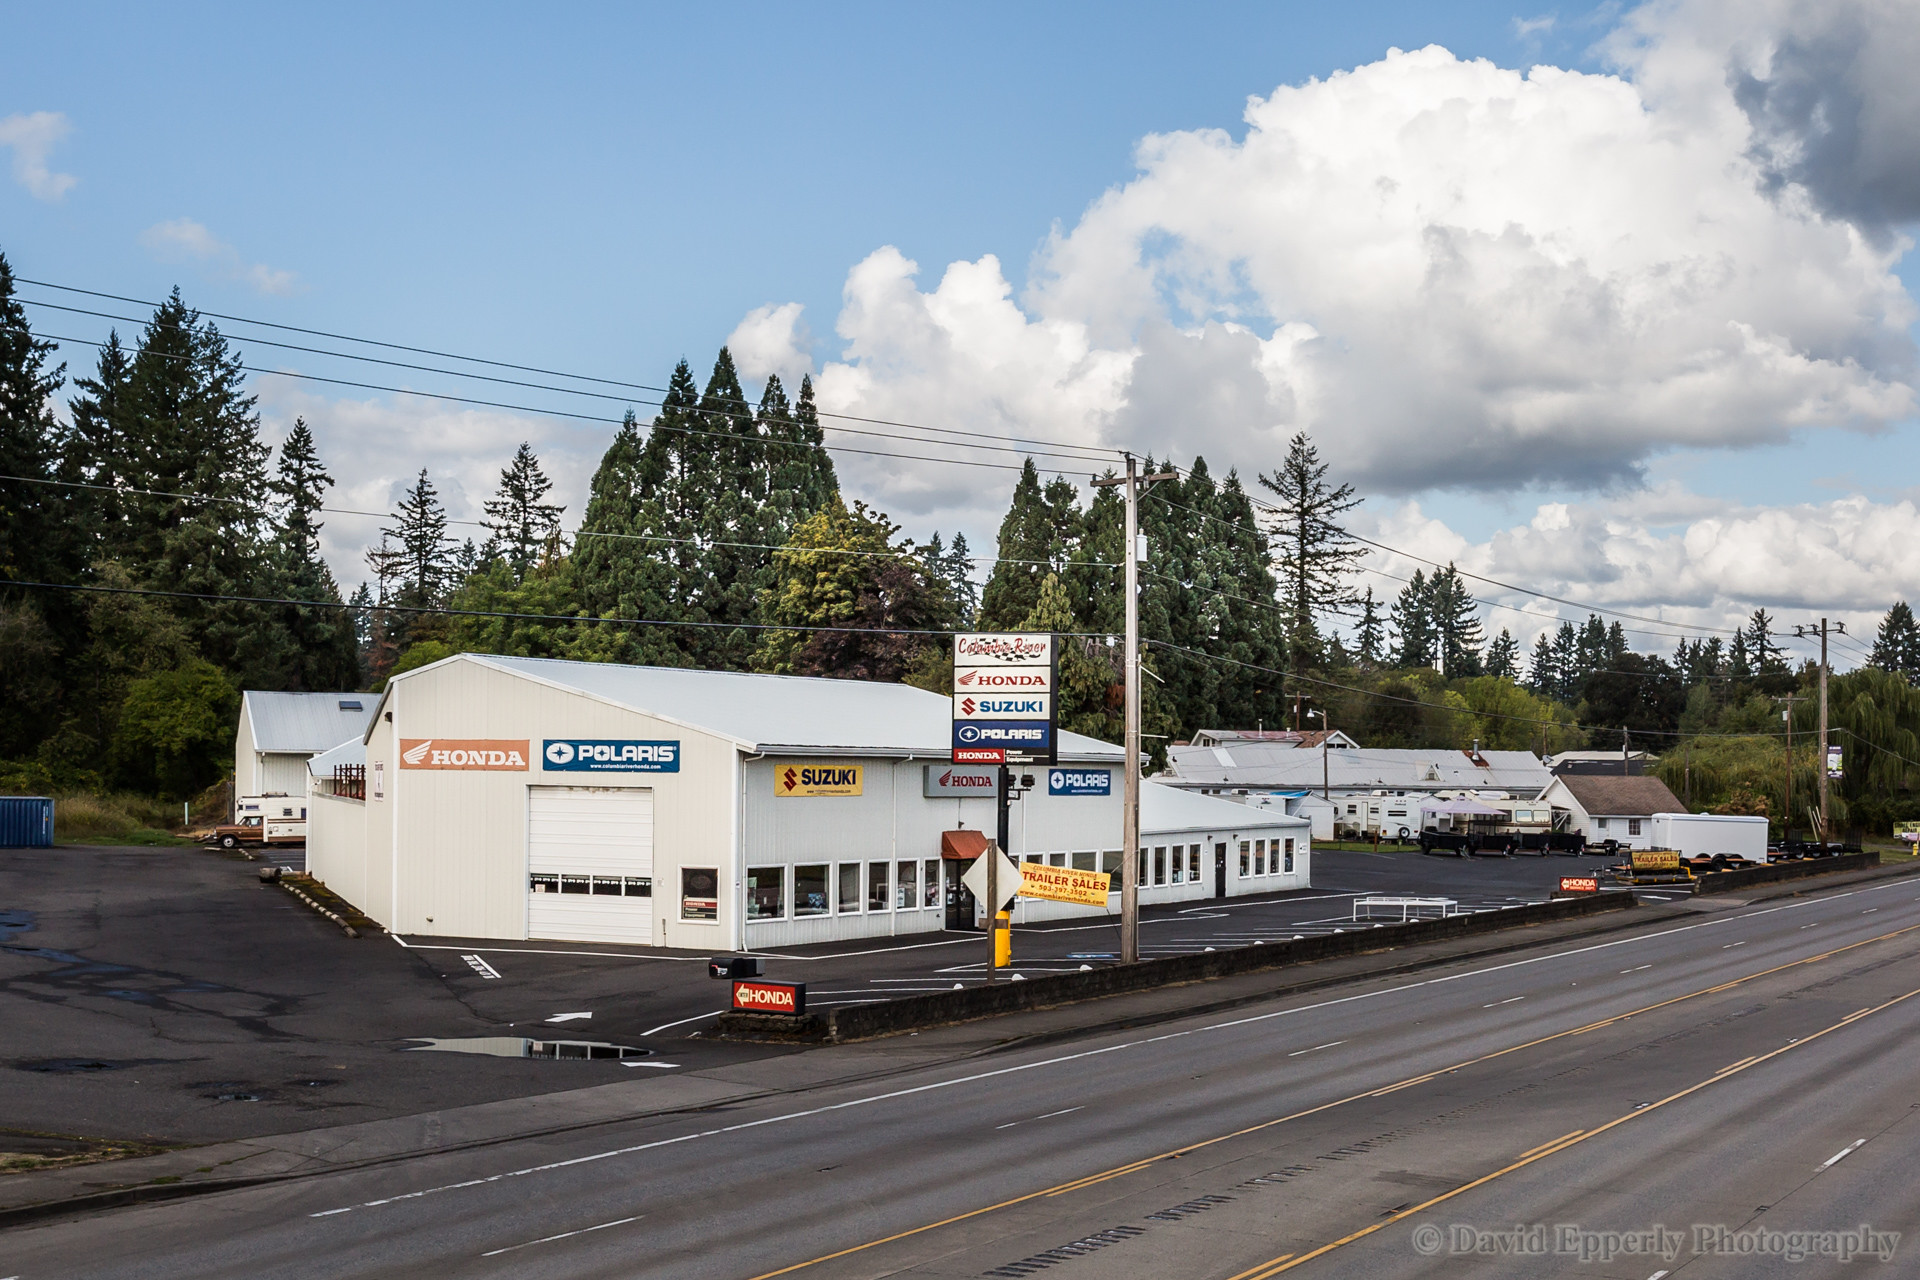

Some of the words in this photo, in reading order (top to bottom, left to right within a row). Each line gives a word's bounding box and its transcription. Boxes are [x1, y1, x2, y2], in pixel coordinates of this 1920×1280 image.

[958, 637, 1011, 654] Columbia
[1014, 637, 1046, 654] River
[977, 676, 1046, 685] HONDA
[979, 701, 1043, 712] SUZUKI
[980, 729, 1042, 739] POLARIS
[431, 749, 526, 766] HONDA
[578, 745, 675, 762] POLARIS
[957, 752, 1000, 760] HONDA
[801, 768, 856, 786] SUZUKI
[951, 775, 993, 787] HONDA
[1065, 773, 1109, 787] POLARIS
[1033, 865, 1061, 874] COLUMBIA
[1022, 871, 1069, 887] TRAILER
[1071, 878, 1107, 891] SALES
[1569, 878, 1596, 887] HONDA
[1038, 884, 1088, 897] 503-397-3502
[1019, 890, 1105, 906] www.columbiariverhonda.com
[749, 989, 794, 1006] HONDA
